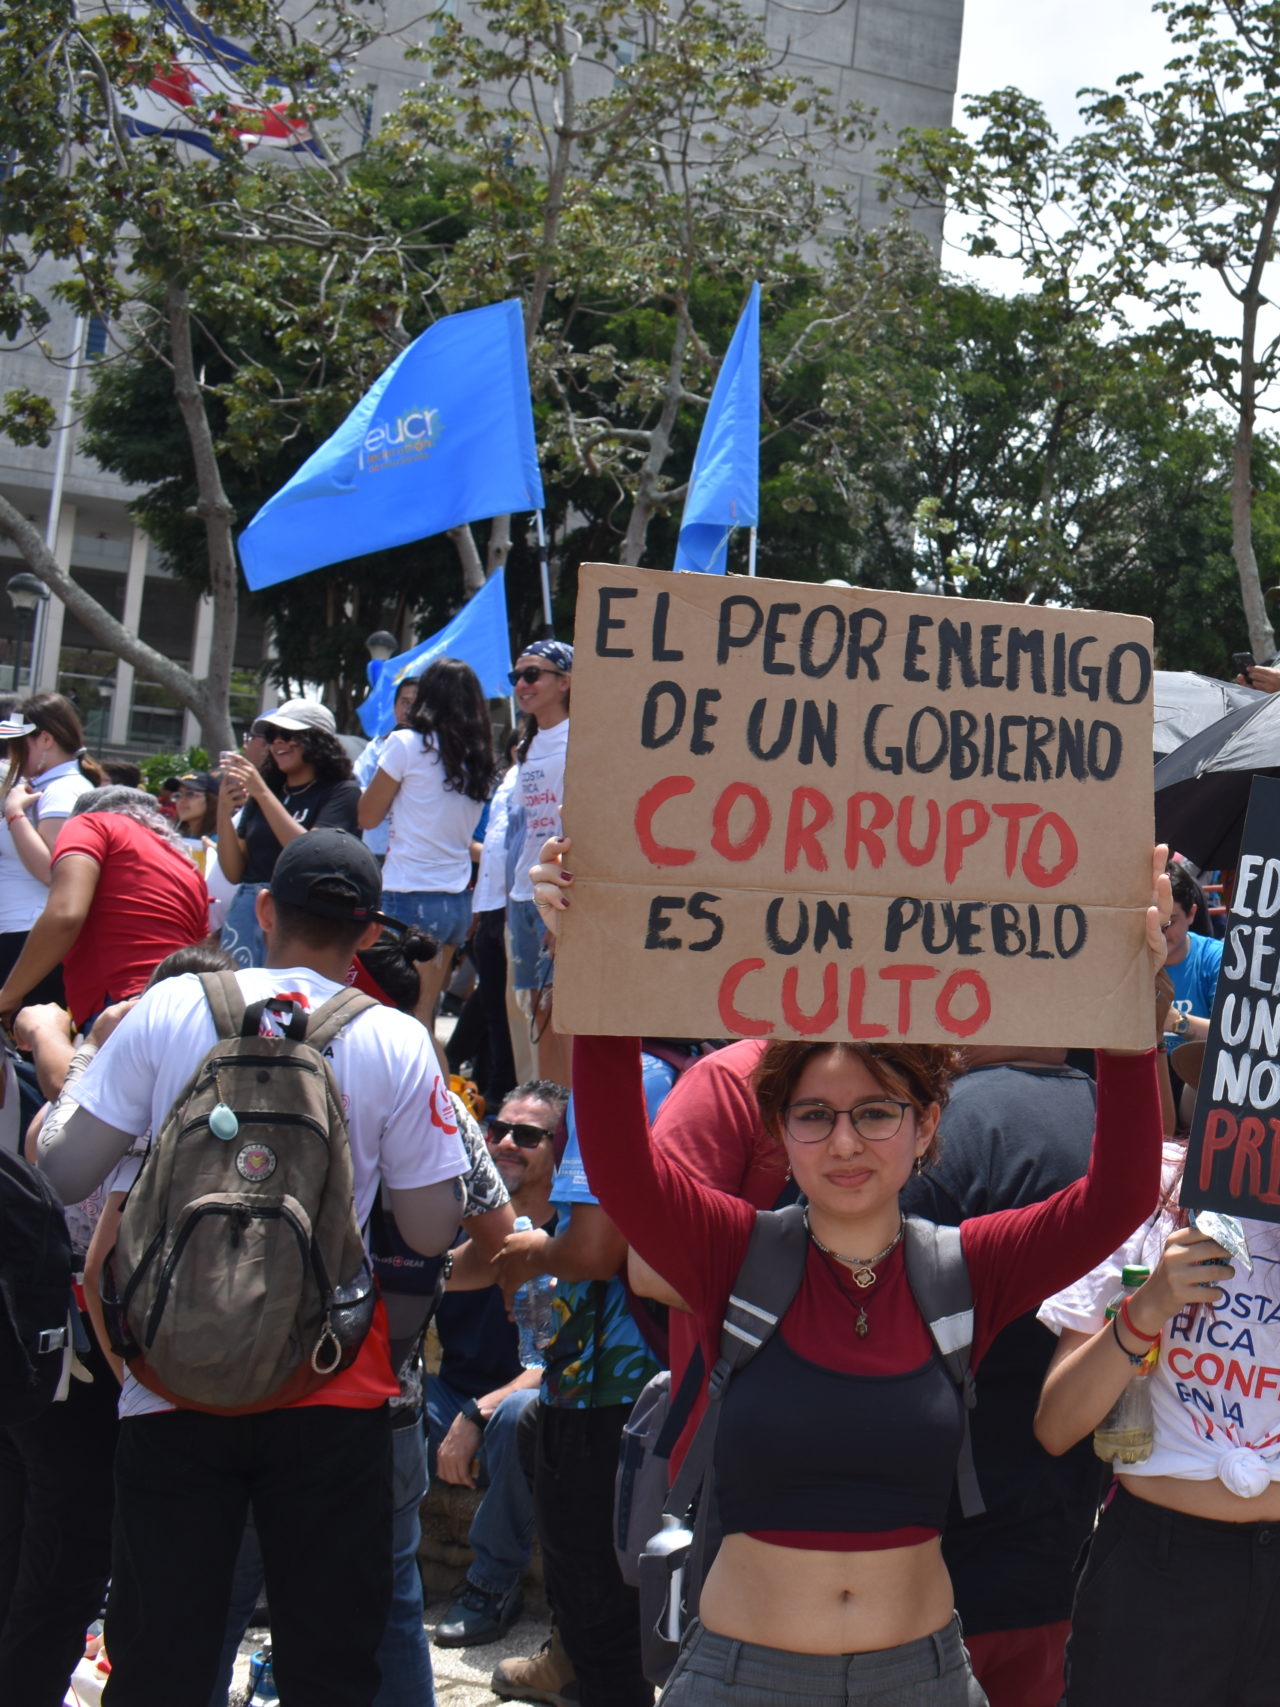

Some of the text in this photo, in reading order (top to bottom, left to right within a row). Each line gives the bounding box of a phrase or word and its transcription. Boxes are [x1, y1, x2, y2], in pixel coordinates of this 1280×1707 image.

[598, 587, 1151, 704] EL PEOR ENEMIGO
[641, 681, 1123, 782] DE UN GOBIERNO
[635, 775, 1079, 888] CORRUPTO
[644, 892, 1088, 959] ES UN PUEBLO
[718, 957, 991, 1038] CULTO
[1170, 1313, 1255, 1357] RICA
[1175, 1382, 1244, 1428] EN LA
